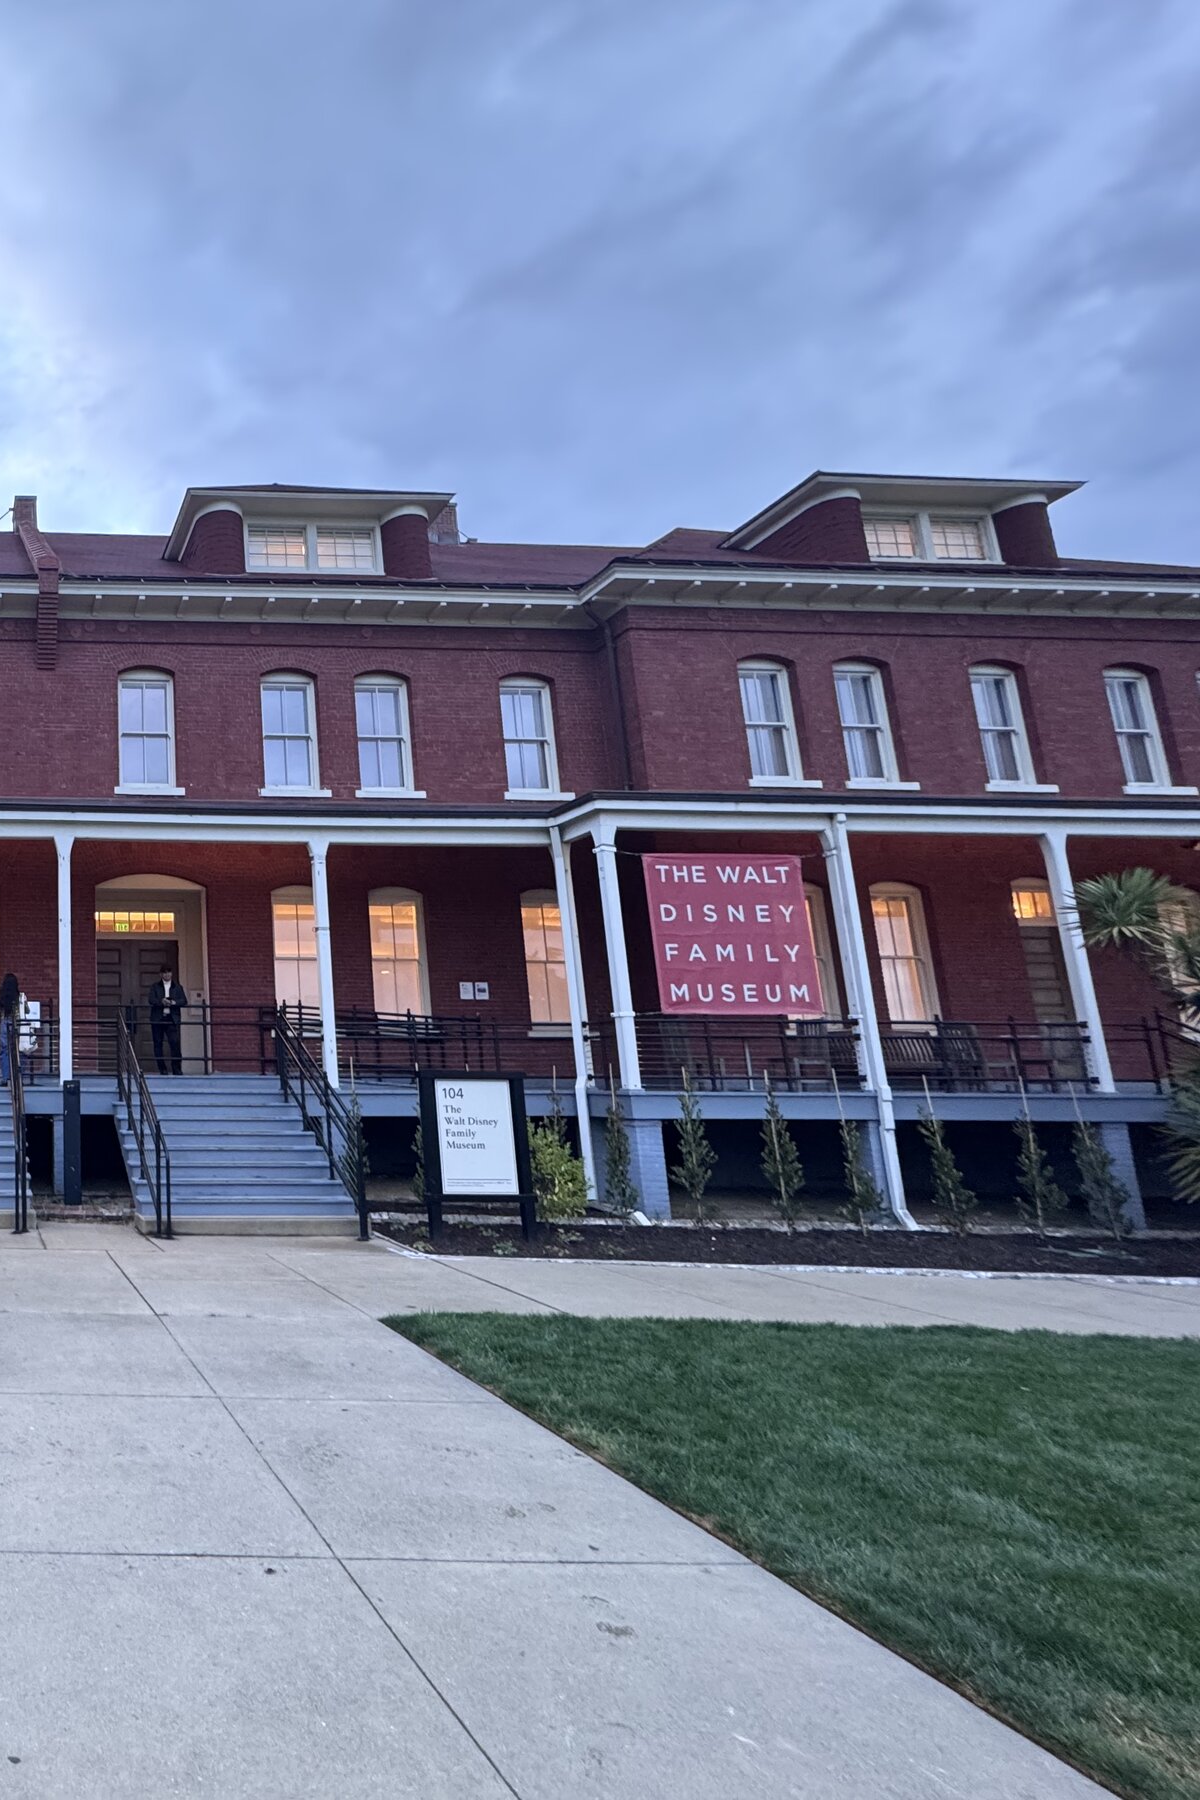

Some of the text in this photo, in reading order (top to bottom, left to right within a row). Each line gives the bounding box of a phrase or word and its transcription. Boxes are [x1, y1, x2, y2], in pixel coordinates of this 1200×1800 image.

[655, 865, 789, 883] THE WALT
[660, 904, 793, 922] DISNEY
[665, 944, 799, 962] FAMILY
[671, 984, 809, 1002] MUSEUM
[442, 1087, 464, 1099] 104
[443, 1104, 462, 1114] The
[444, 1116, 499, 1129] Walt Disney
[445, 1128, 477, 1140] Family
[446, 1140, 486, 1150] Museum
